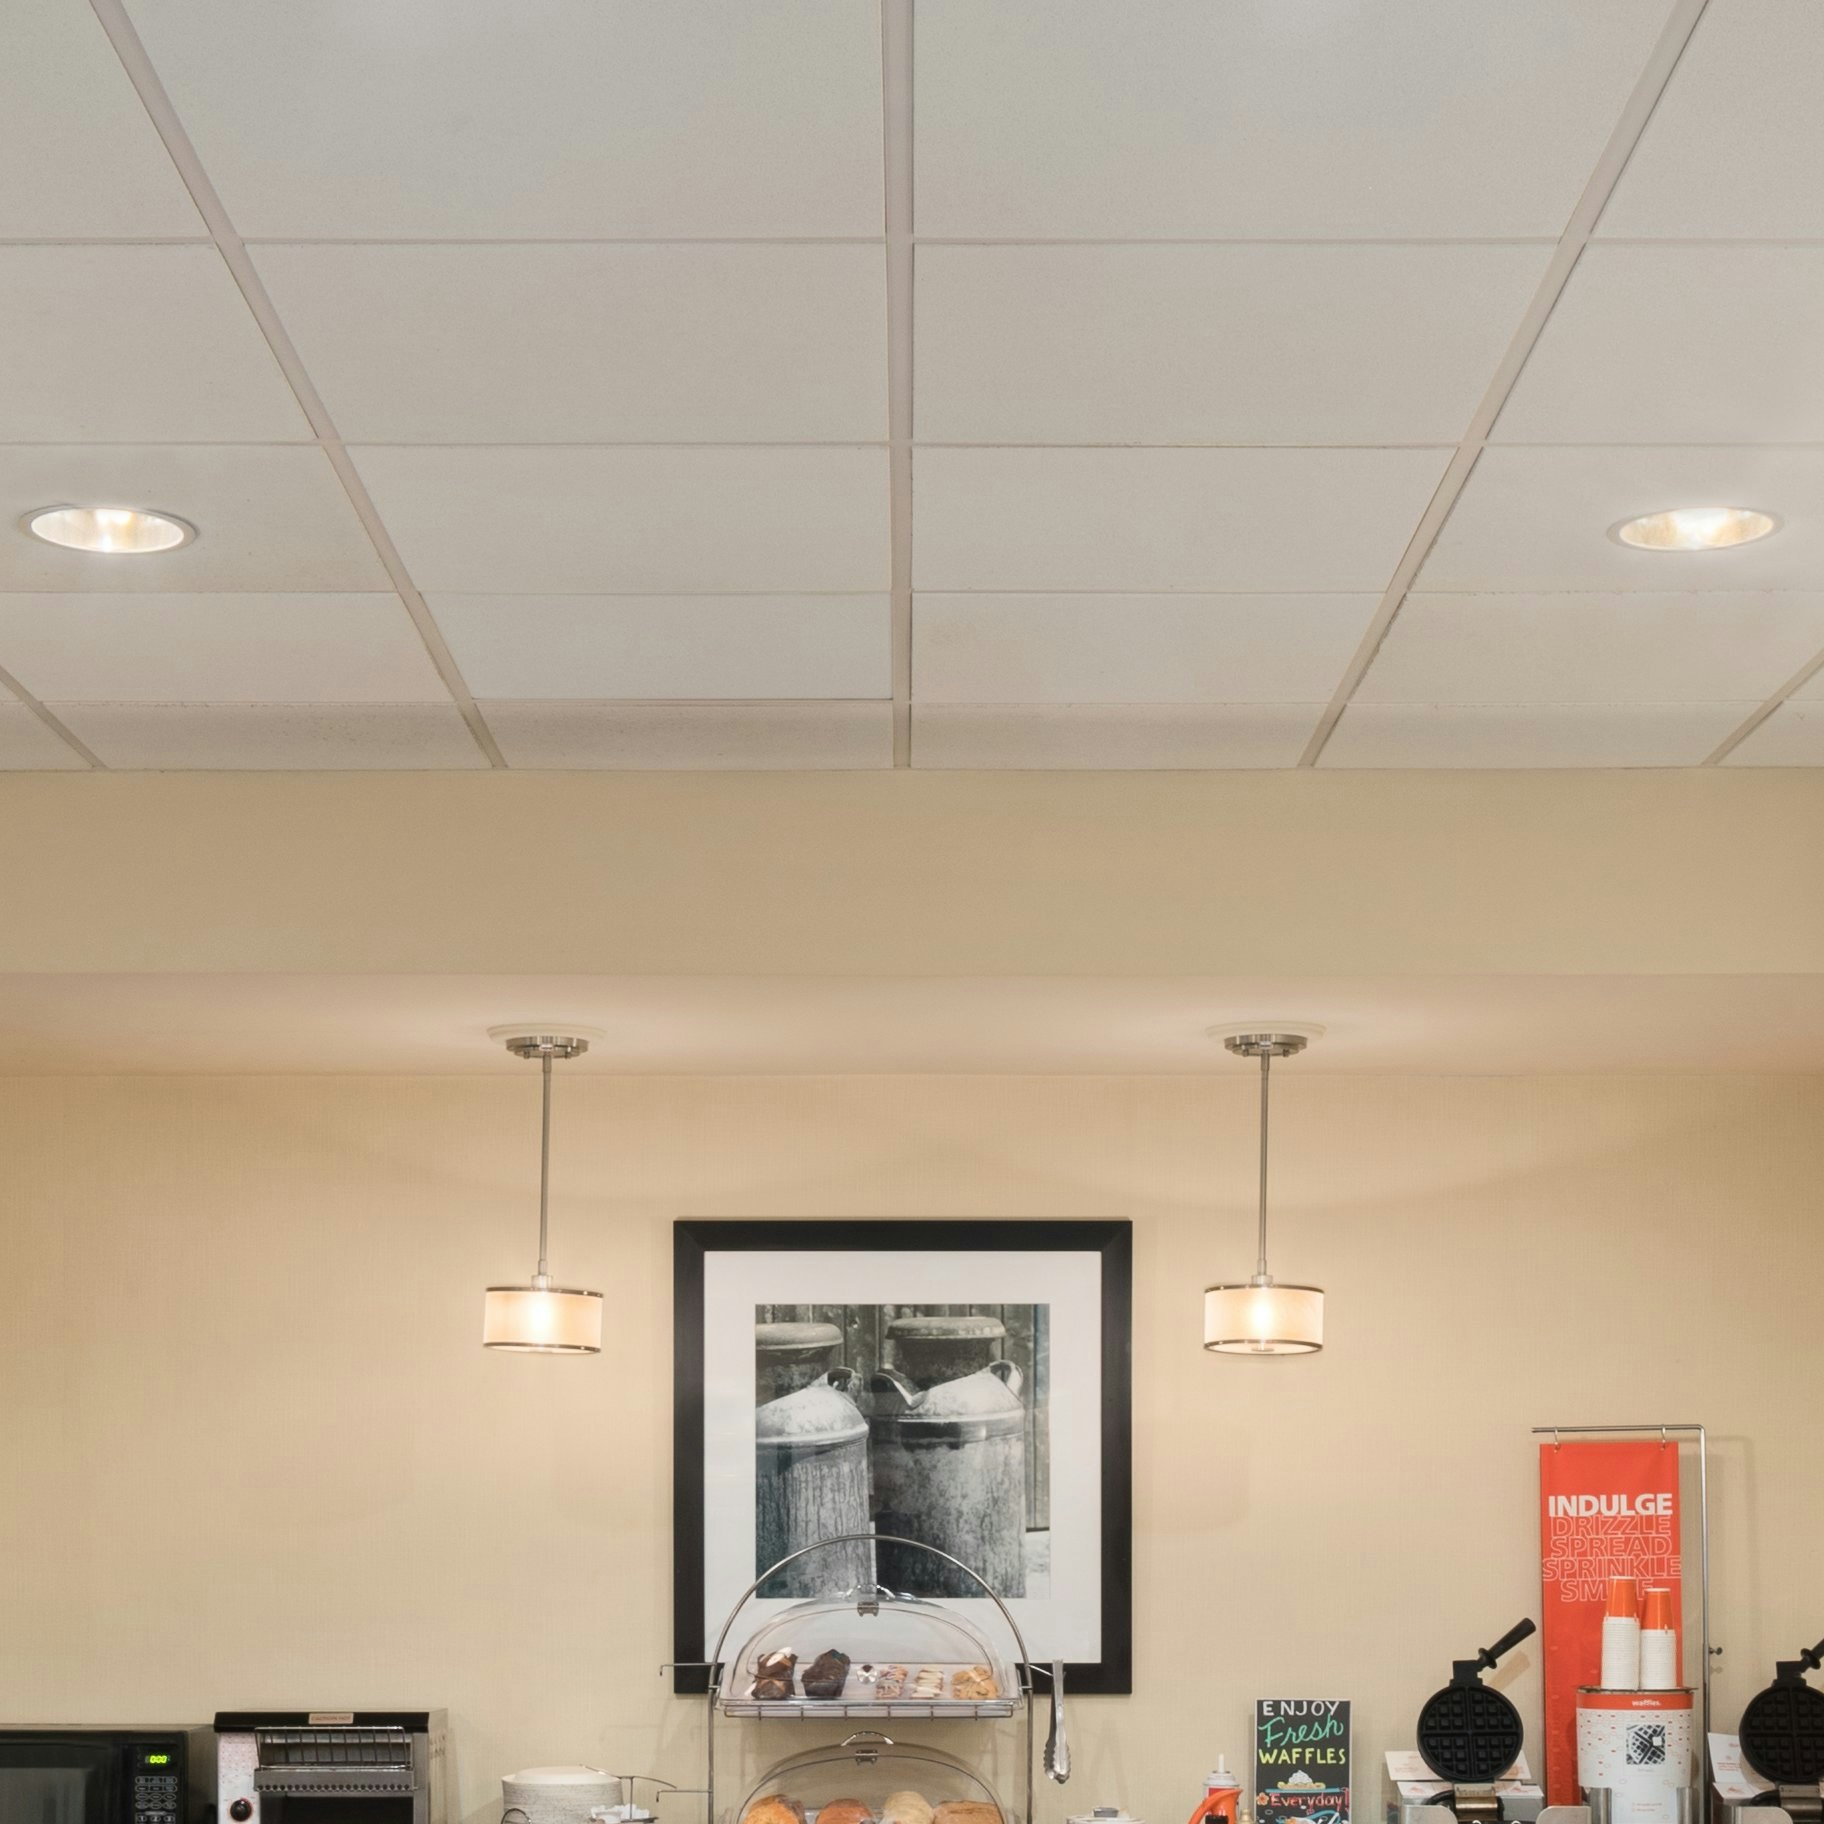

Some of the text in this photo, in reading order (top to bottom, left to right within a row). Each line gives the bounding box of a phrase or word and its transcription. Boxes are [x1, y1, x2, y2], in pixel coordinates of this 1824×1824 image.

[1548, 1493, 1673, 1517] INDULGE
[1550, 1515, 1671, 1537] DRIZZLE
[1550, 1536, 1673, 1559] SPREAD
[1542, 1556, 1682, 1581] SPRINKLE
[1263, 1701, 1339, 1716] ENJOY
[1258, 1713, 1344, 1747] Fresh
[1259, 1748, 1346, 1764] WAFFLES
